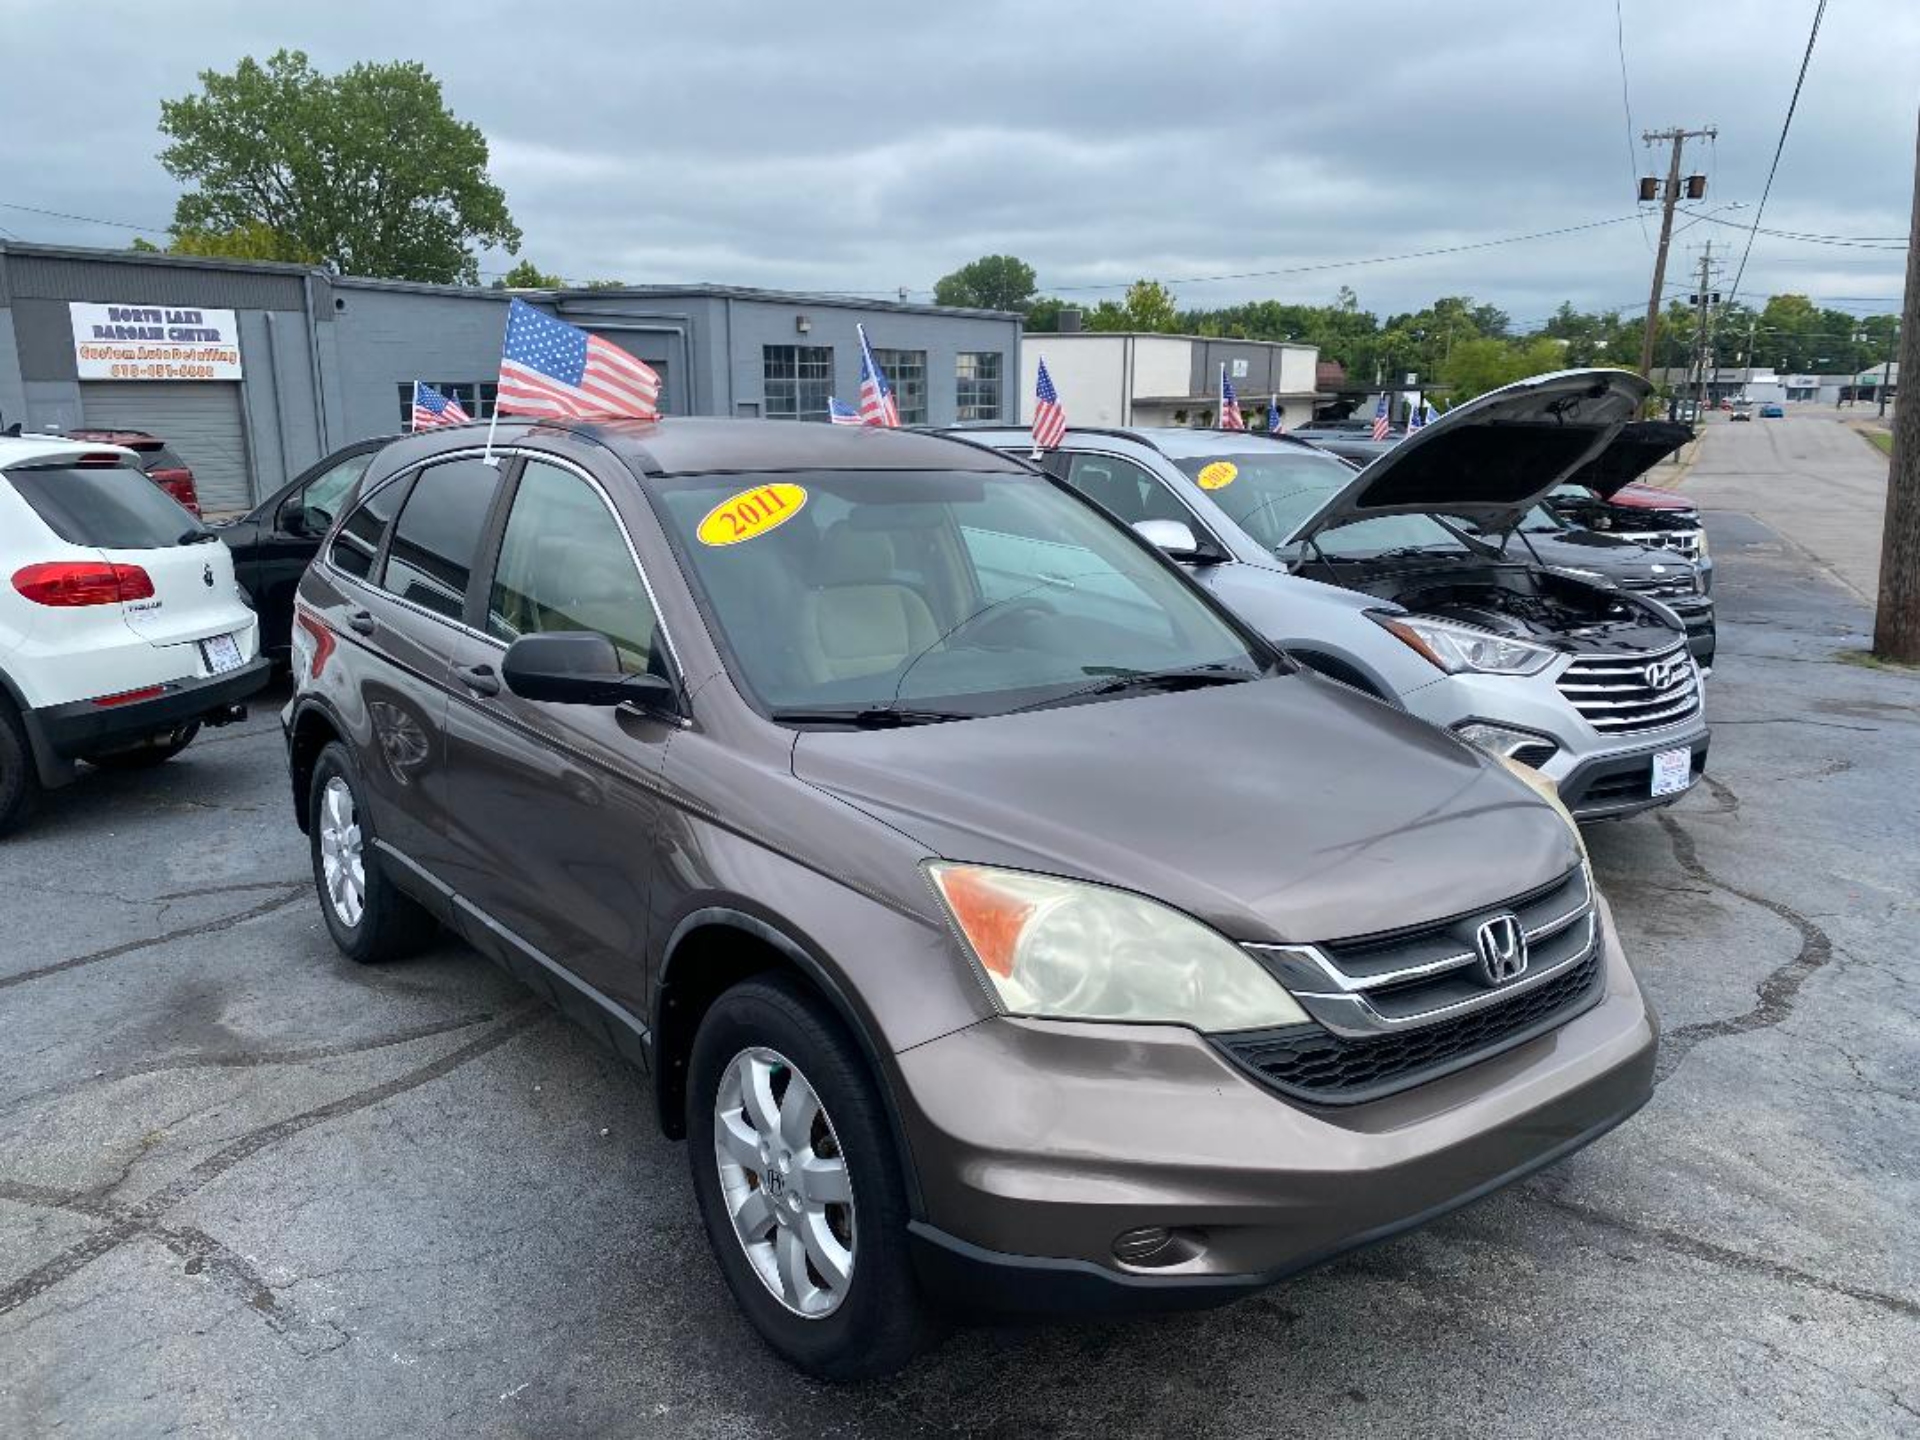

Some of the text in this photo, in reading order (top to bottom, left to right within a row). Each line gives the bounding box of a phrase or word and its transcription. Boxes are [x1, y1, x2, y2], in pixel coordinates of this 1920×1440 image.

[108, 308, 163, 323] NORTH
[93, 325, 221, 341] BARGAIN CENTER
[80, 345, 237, 363] Custom Auto Detailing
[719, 488, 786, 536] 2011
